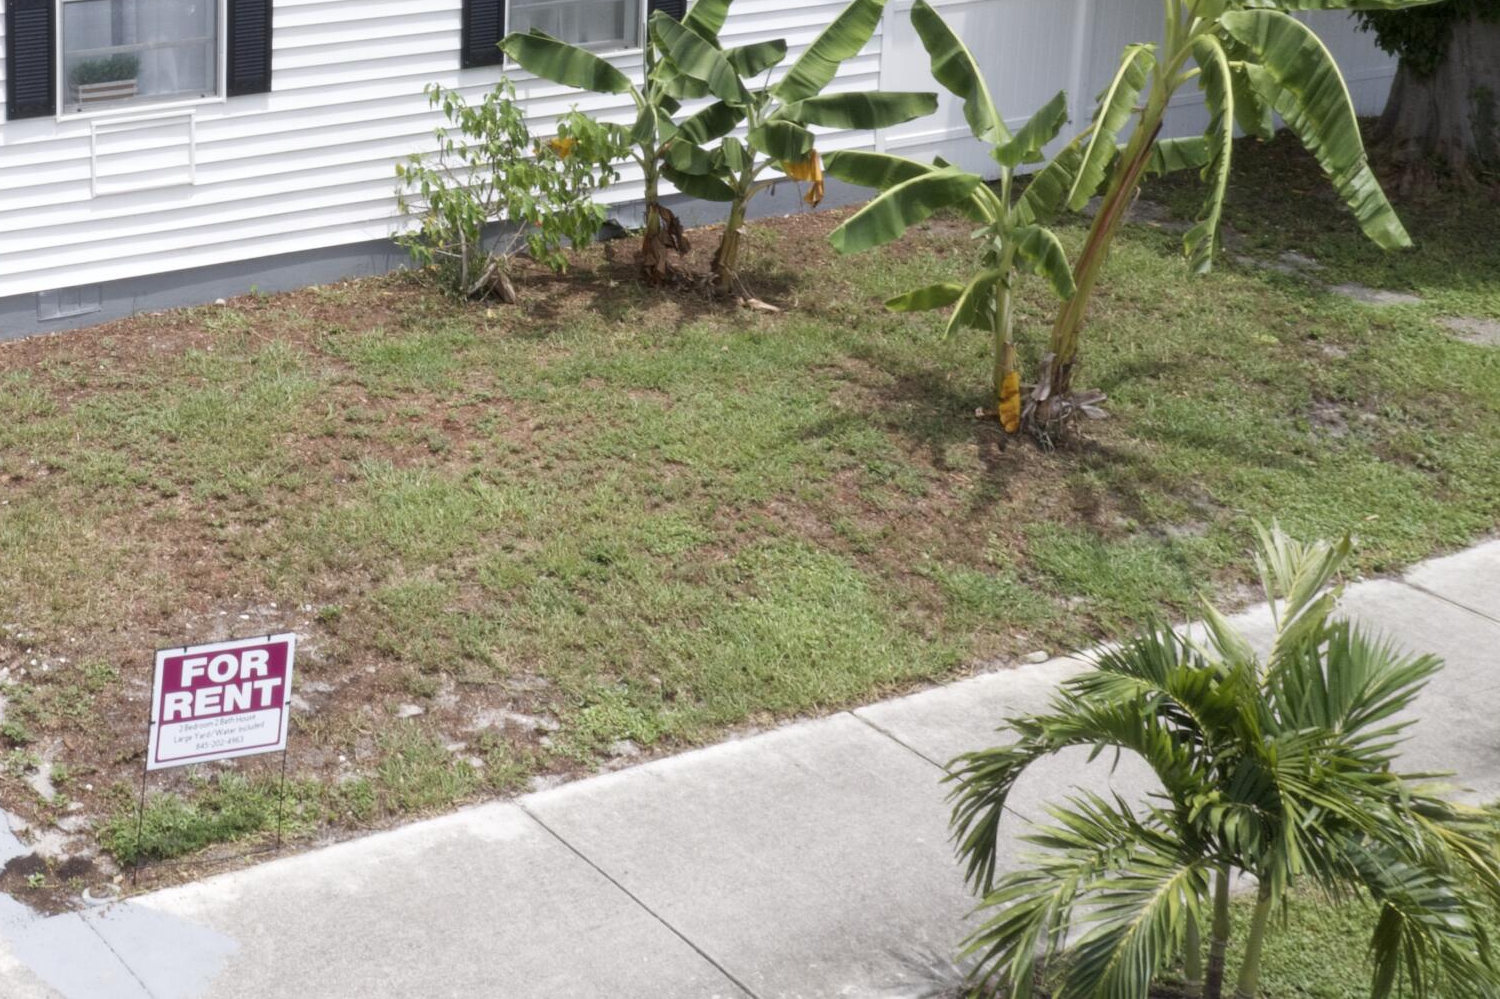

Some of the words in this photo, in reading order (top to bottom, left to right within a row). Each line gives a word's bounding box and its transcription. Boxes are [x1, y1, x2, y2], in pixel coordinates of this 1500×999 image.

[180, 649, 270, 688] FOR
[162, 677, 282, 722] RENT
[184, 721, 213, 732] Bedroom
[219, 716, 235, 727] Bath
[235, 714, 257, 724] House
[173, 733, 193, 744] Large
